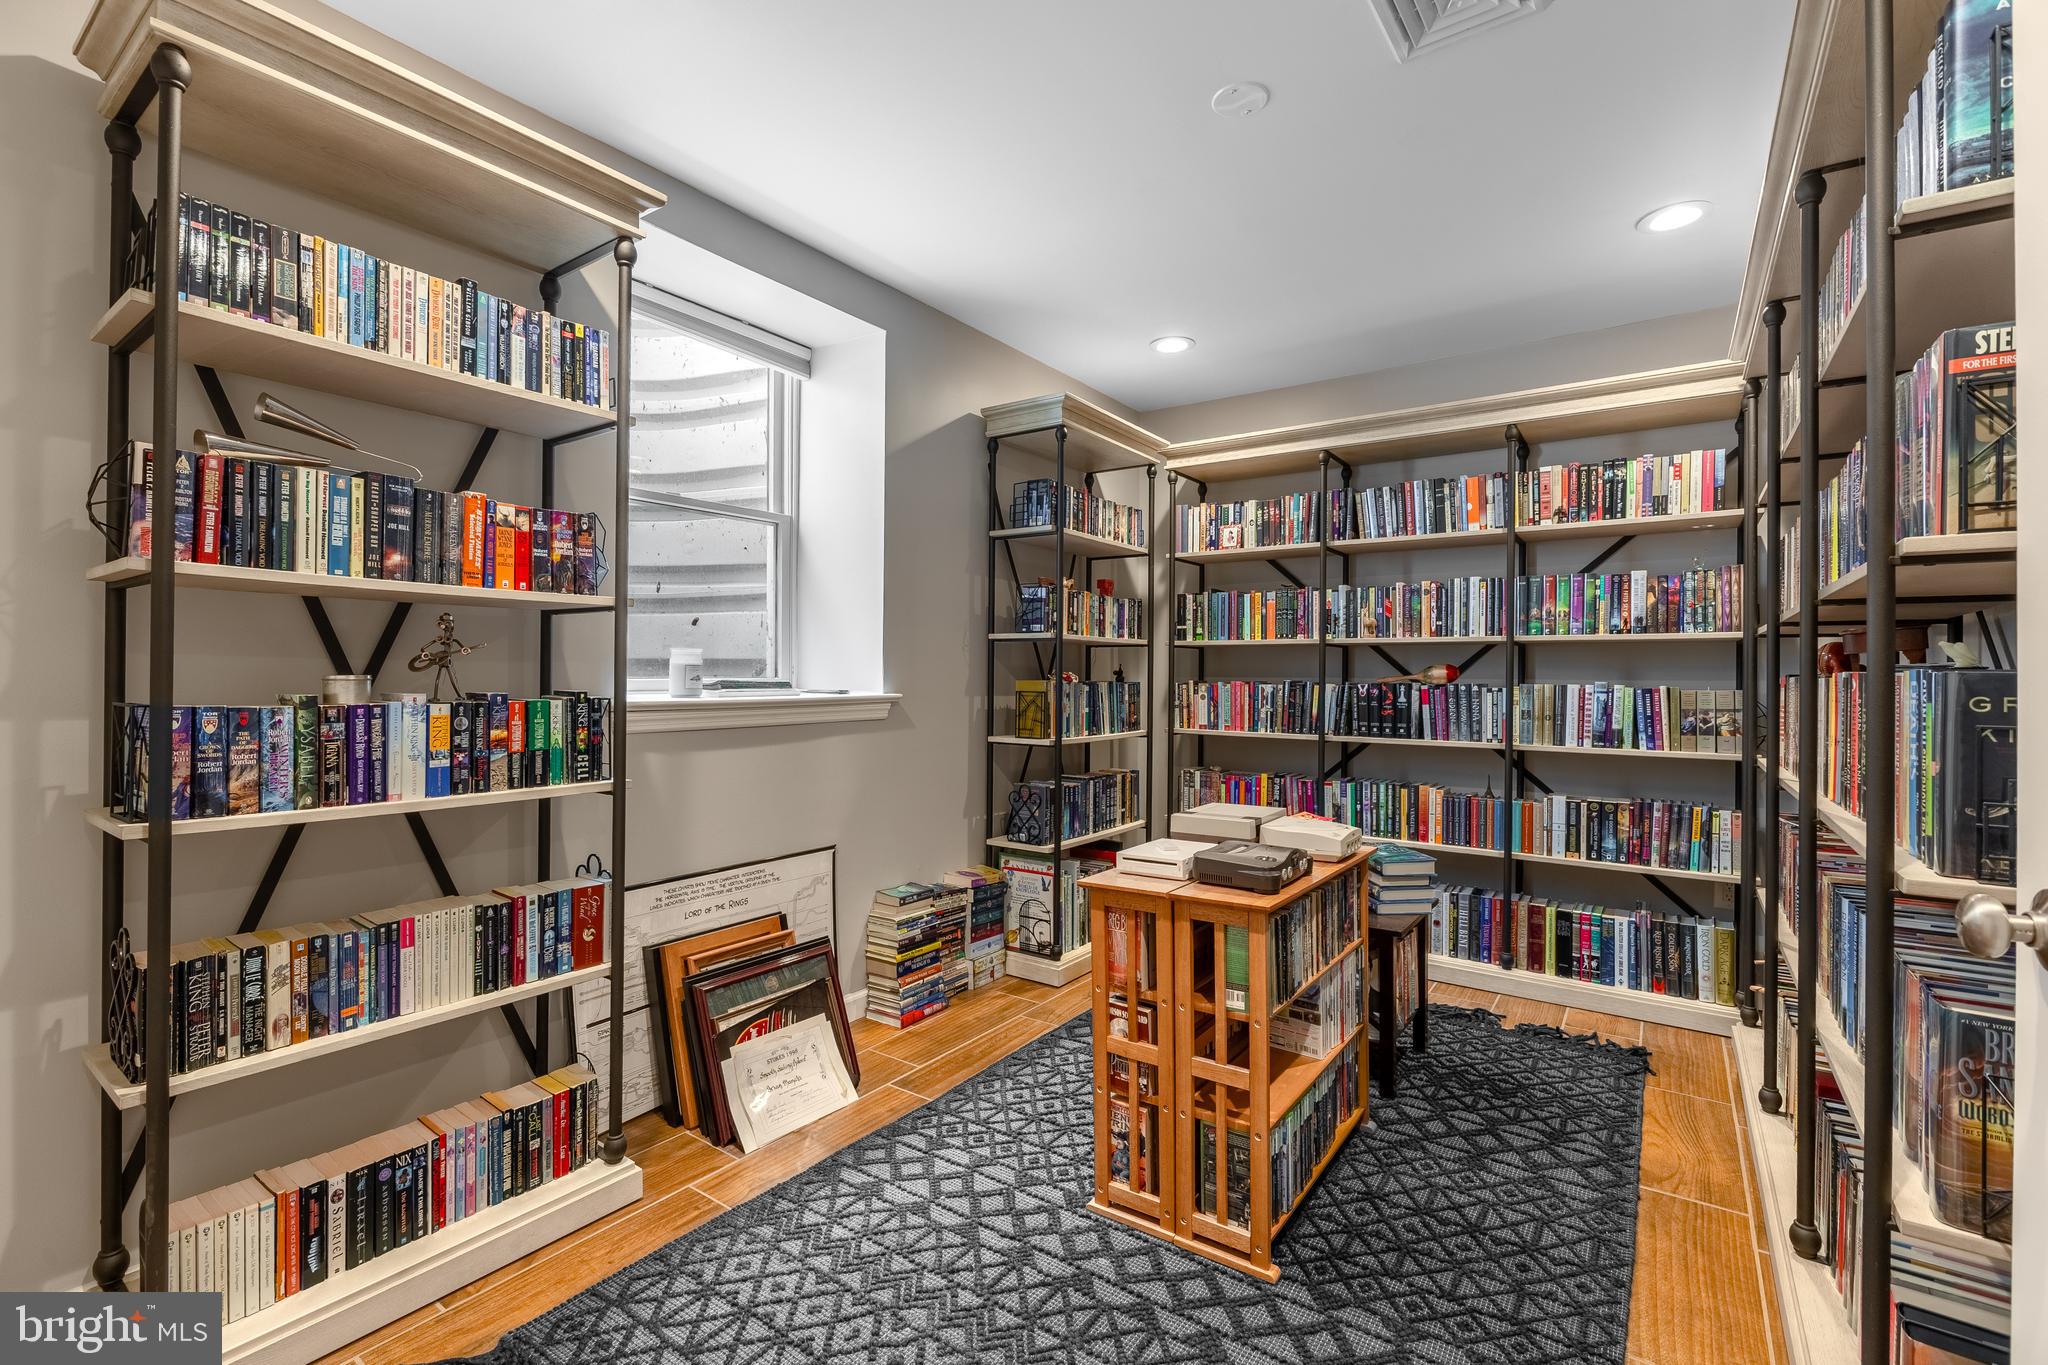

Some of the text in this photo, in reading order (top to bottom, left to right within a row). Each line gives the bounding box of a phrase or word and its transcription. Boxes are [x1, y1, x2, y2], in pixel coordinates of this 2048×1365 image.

[1936, 33, 1944, 91] RICHARD
[1962, 355, 1998, 370] FOR THE
[268, 729, 291, 737] Robert
[432, 716, 442, 749] KING
[197, 766, 223, 774] Jordan
[198, 760, 223, 768] Robert
[300, 726, 315, 782] YSABEL
[325, 741, 341, 768] TIGANA
[577, 754, 589, 781] CELL
[579, 897, 589, 919] Wind
[591, 895, 600, 917] Gone
[684, 908, 703, 920] LORD
[714, 903, 726, 912] THE
[728, 897, 749, 910] RINGS
[1458, 909, 1469, 949] HELL BENT
[1653, 930, 1662, 969] RED RISING
[1668, 933, 1676, 972] GOLDEN SON
[1684, 935, 1692, 976] MORNING STAR
[1700, 928, 1711, 972] IRON GOLD
[1719, 932, 1730, 976] DARK AGE
[189, 974, 203, 1013] KING
[201, 972, 210, 1010] STEPHEN
[197, 1021, 211, 1060] PETER
[245, 1005, 254, 1044] MANAGER
[255, 1002, 263, 1041] THE NIGHT
[1971, 1019, 2015, 1032] NEW YORK
[189, 1024, 200, 1062] STRAUB
[529, 1112, 539, 1142] CALL
[396, 1152, 413, 1166] NIX
[415, 1145, 427, 1155] NIX
[333, 1206, 344, 1260] SABRIEL
[356, 1196, 366, 1250] LIRAEL
